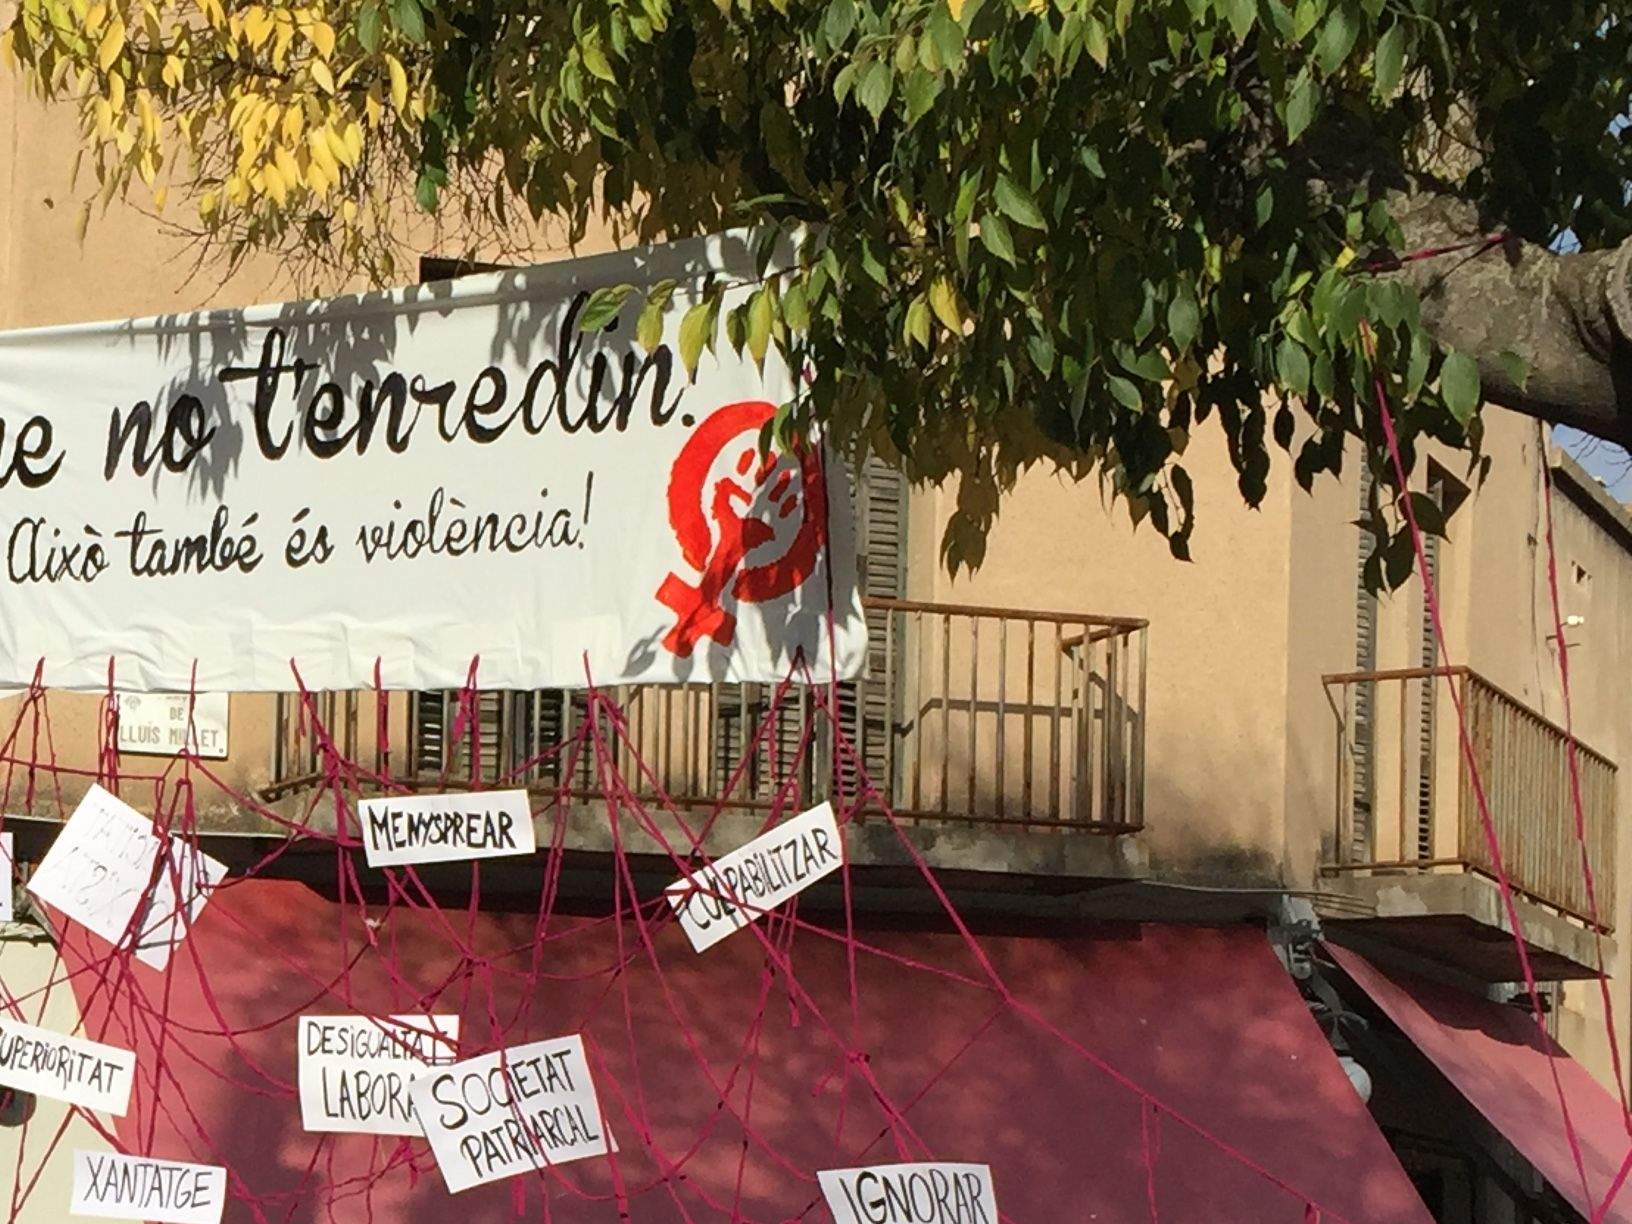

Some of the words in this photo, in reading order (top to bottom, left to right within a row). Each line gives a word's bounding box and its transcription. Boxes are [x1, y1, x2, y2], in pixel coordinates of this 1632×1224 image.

[104, 393, 216, 481] no
[115, 504, 264, 577] també
[284, 507, 335, 568] és
[357, 470, 594, 564] violència!
[369, 809, 515, 852] MENYSPREAR
[432, 1048, 577, 1130] SOCIETAT
[460, 1104, 599, 1178] PATRIARCAL
[84, 1155, 214, 1210] XANTATGE
